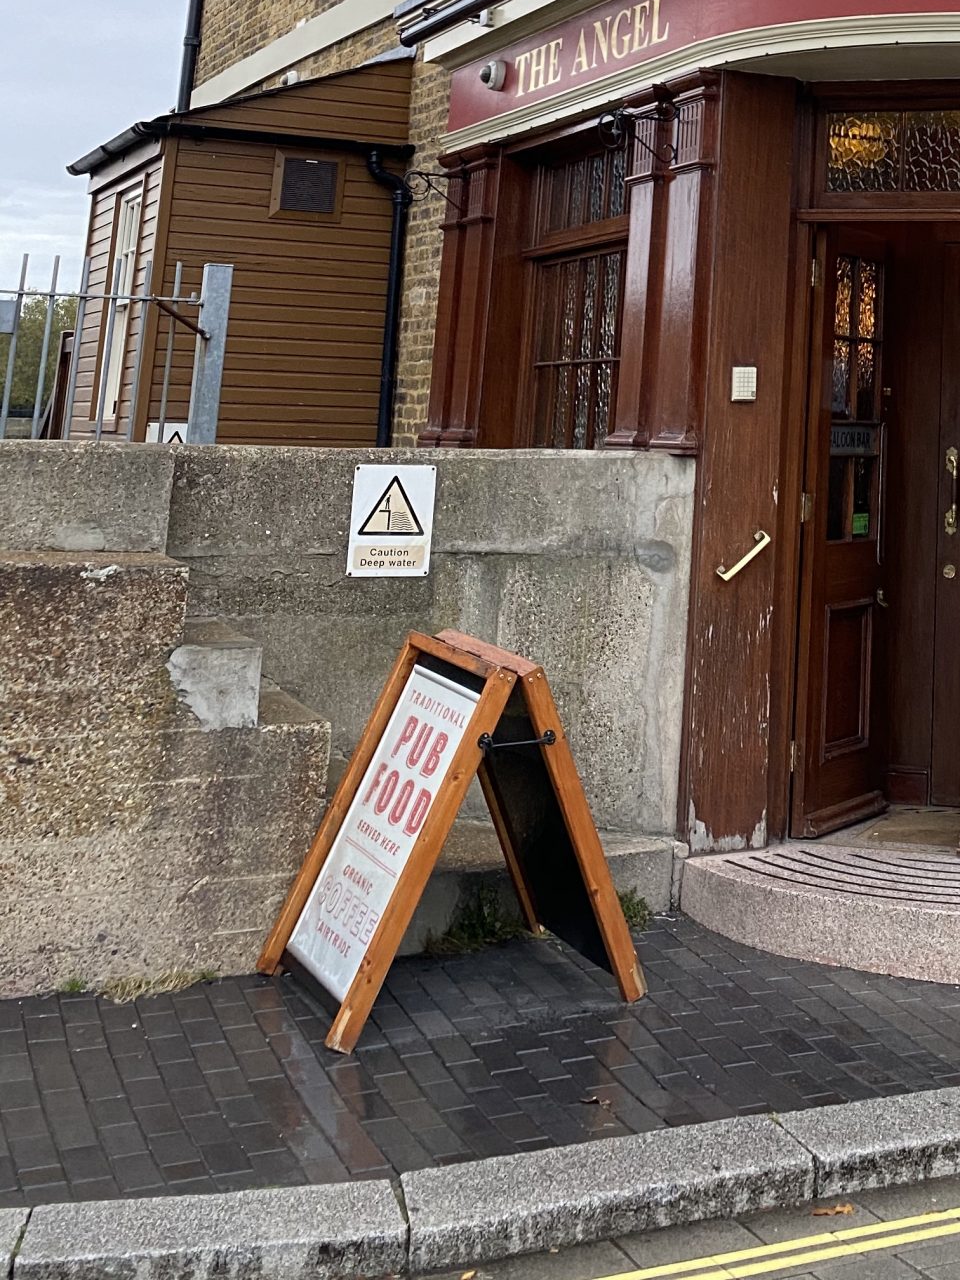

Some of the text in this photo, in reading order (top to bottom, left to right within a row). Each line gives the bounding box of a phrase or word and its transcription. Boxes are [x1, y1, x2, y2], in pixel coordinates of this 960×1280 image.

[514, 36, 563, 98] THE
[831, 431, 855, 448] ALOON
[360, 558, 417, 568] Deep water
[370, 548, 409, 556] Caution
[409, 689, 467, 729] TRADITIONAL
[390, 714, 449, 778] PUB
[362, 761, 432, 837] FOOD
[357, 819, 401, 857] SERVED HERE
[342, 864, 374, 896] ORGANIC
[318, 875, 380, 946] COFFEE
